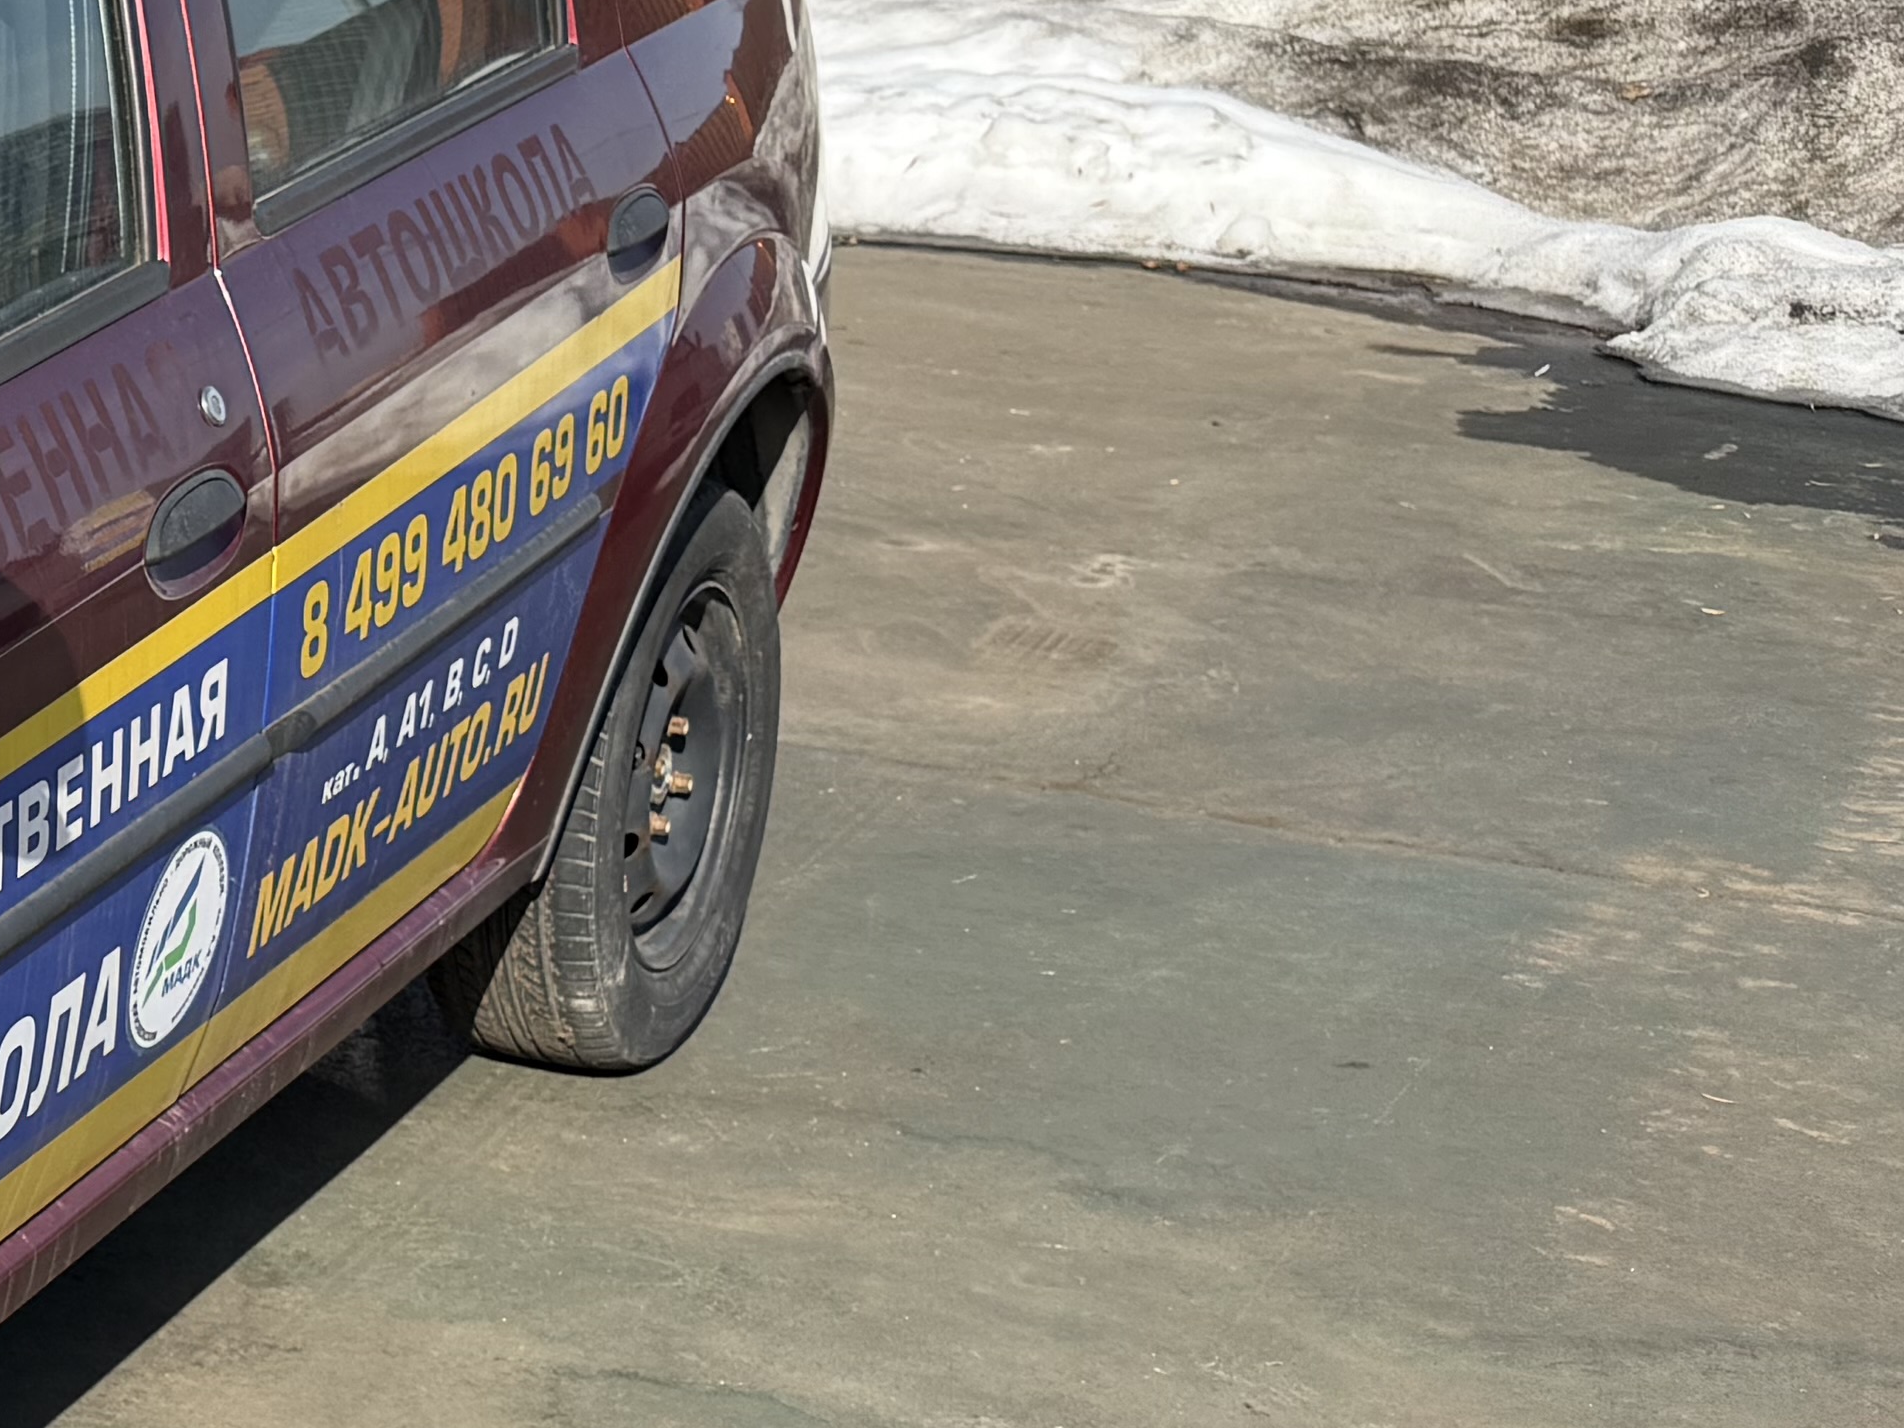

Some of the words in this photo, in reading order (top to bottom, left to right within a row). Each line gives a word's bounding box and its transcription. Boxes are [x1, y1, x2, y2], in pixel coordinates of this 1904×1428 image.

[293, 124, 597, 368] АВТОШКОЛА
[300, 579, 329, 678] 8
[344, 513, 428, 641] 499
[442, 453, 518, 573] 480
[529, 413, 575, 516] 69
[586, 375, 629, 474] 60
[246, 652, 550, 959] MADK-AUTO.RU
[321, 762, 361, 804] кат.
[497, 616, 520, 669] D
[161, 948, 202, 997] МАДК
